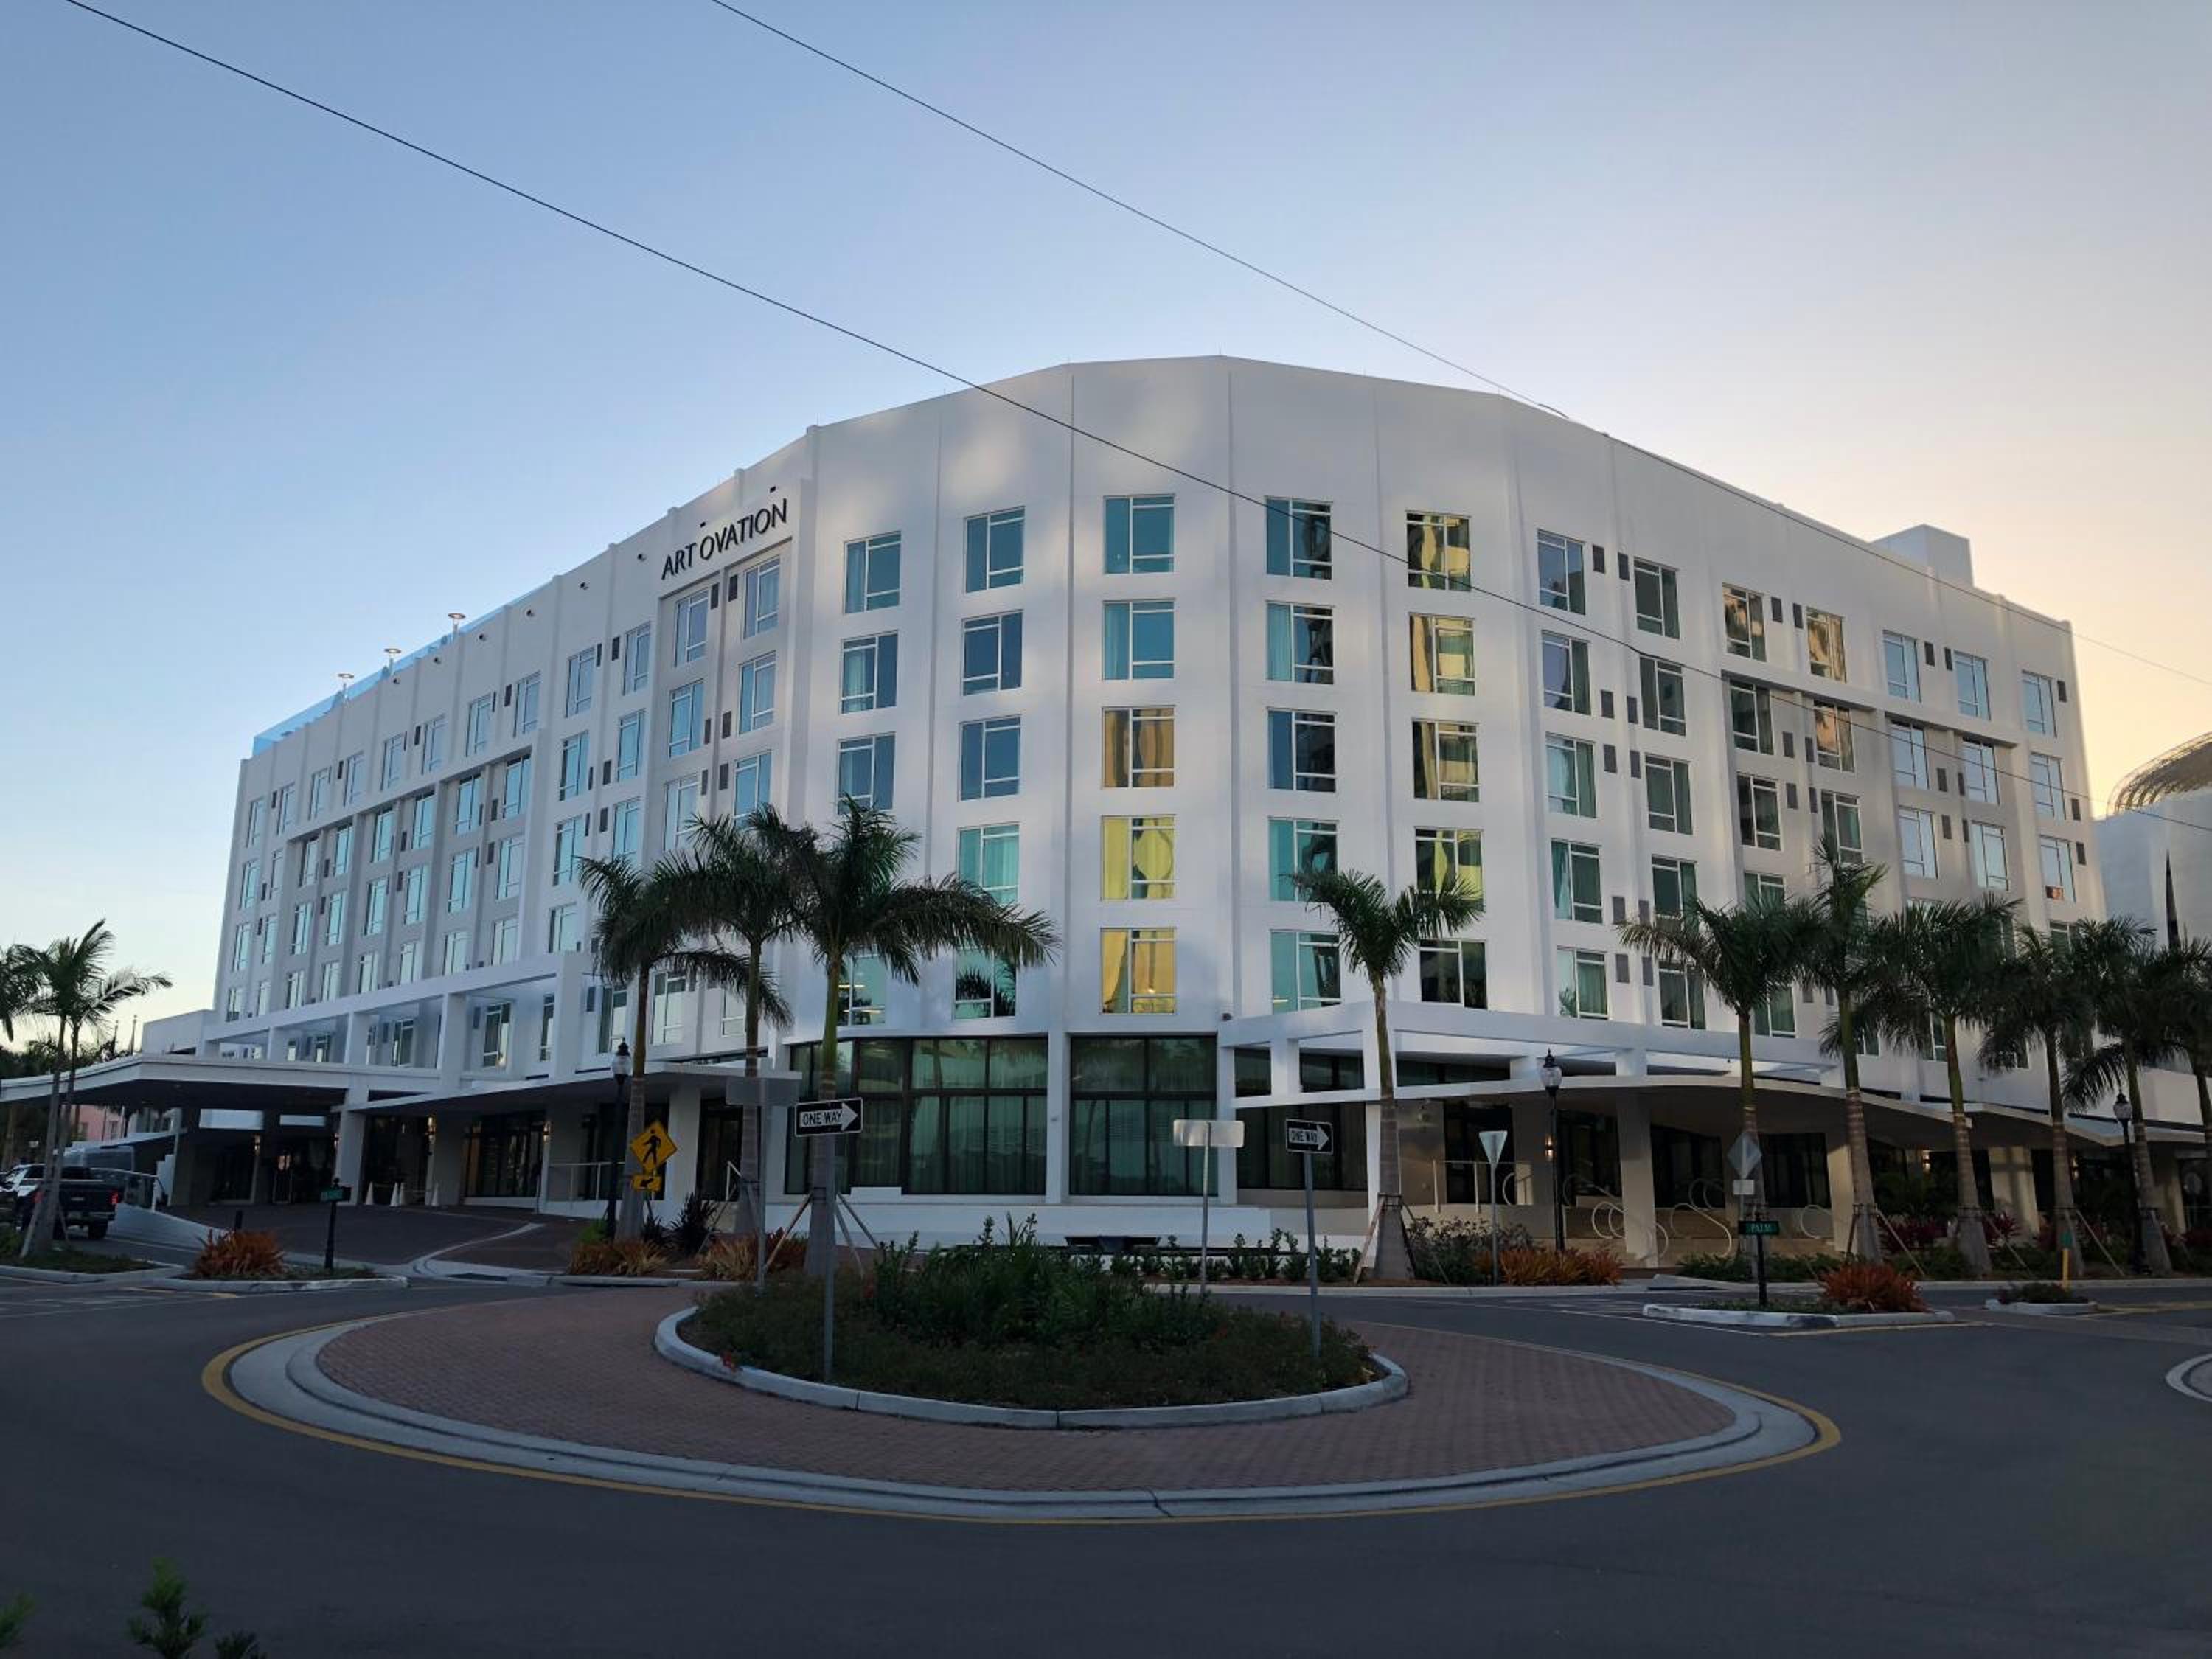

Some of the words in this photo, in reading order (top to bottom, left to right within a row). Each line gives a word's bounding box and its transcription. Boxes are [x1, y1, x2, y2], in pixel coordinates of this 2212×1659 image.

[661, 542, 698, 580] ART
[700, 498, 787, 561] OVATION
[803, 1112, 822, 1126] ONE
[824, 1110, 843, 1124] WAY
